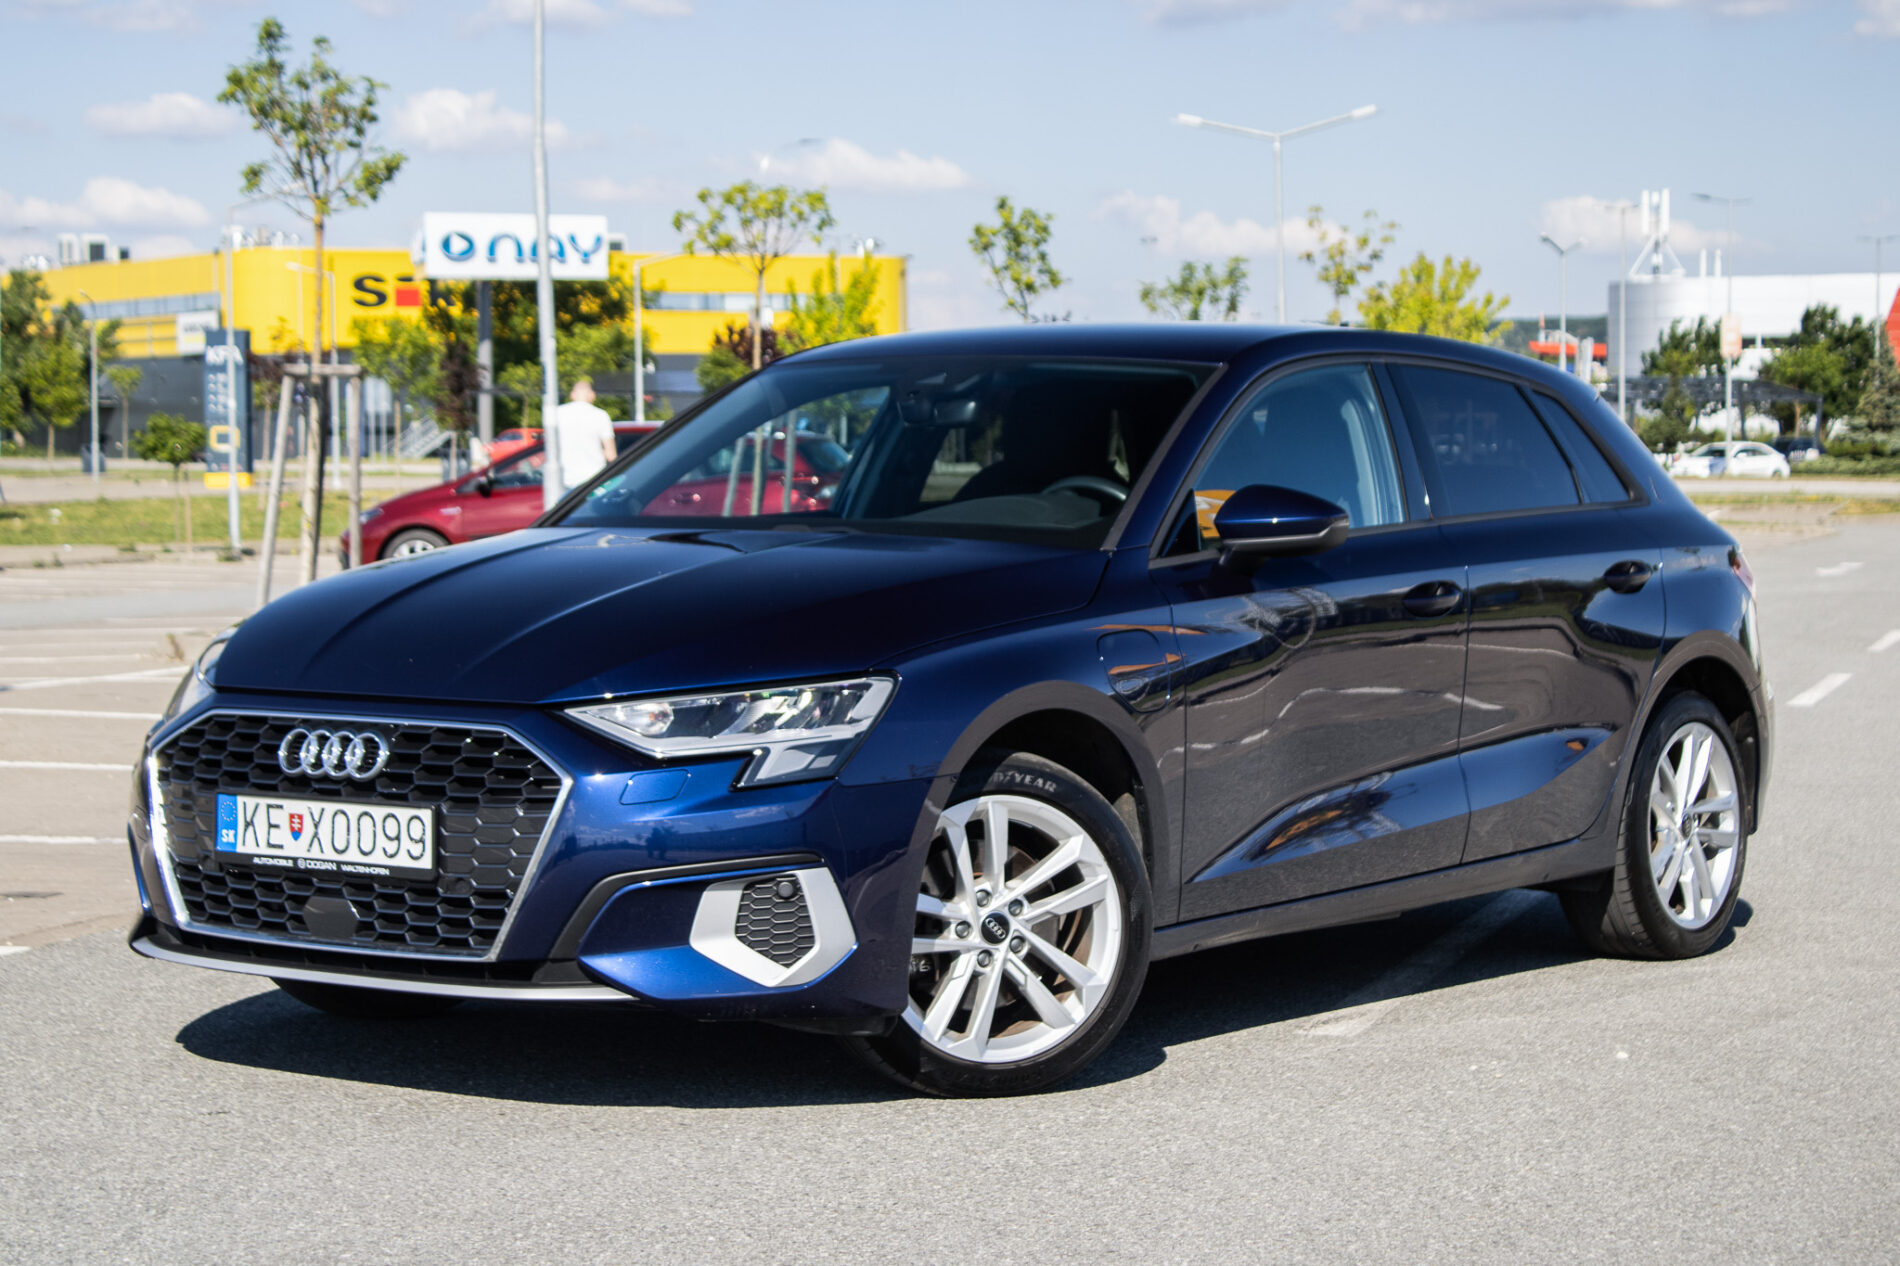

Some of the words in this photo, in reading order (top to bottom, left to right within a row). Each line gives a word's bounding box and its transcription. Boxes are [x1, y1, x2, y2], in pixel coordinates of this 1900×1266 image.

[220, 829, 236, 843] SK
[242, 800, 285, 850] KE
[307, 806, 427, 861] X0099
